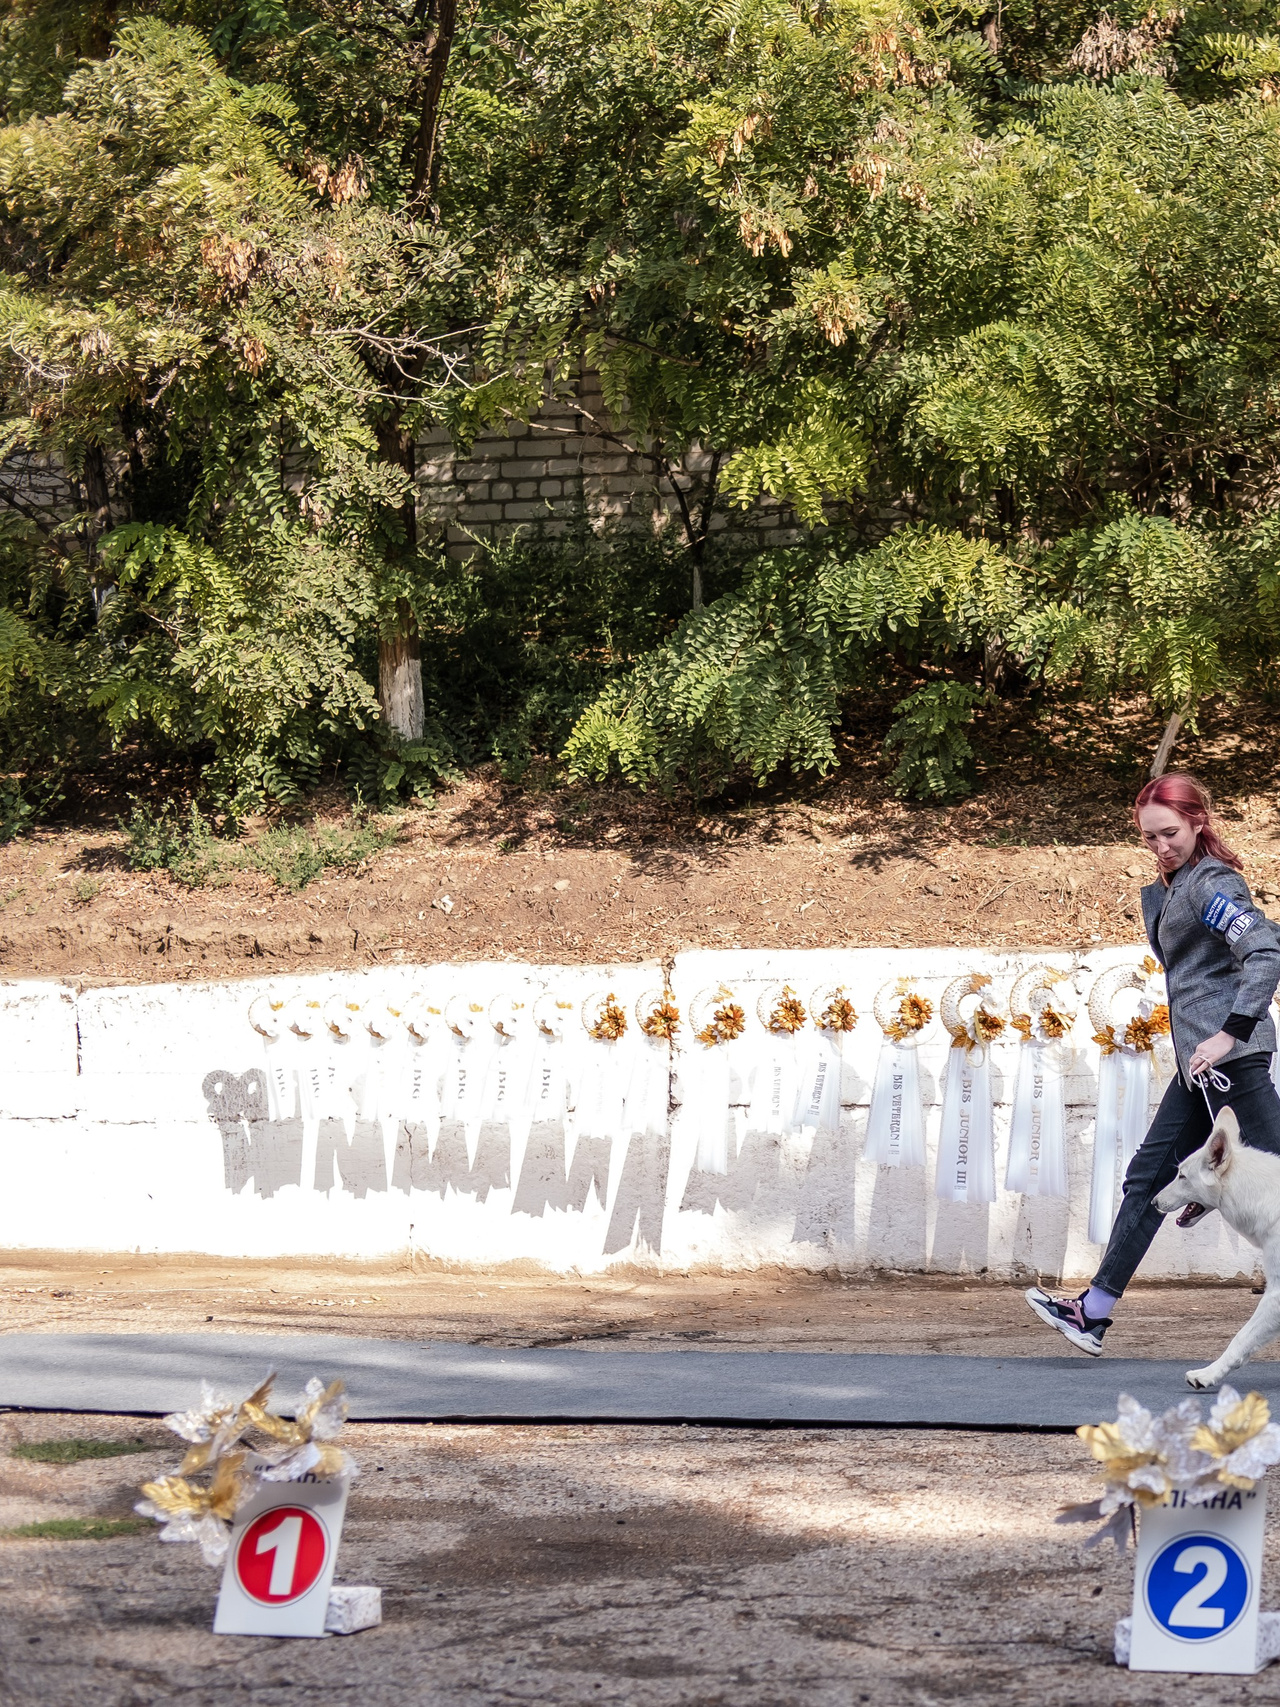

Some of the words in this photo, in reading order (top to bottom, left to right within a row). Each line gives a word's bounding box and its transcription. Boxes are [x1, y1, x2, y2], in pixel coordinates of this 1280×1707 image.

[1205, 896, 1222, 921] УЧАСТНИК
[893, 1074, 903, 1090] BIS
[961, 1079, 972, 1104] BIS
[1033, 1074, 1044, 1100] BIS
[889, 1093, 902, 1141] VETERAN
[1029, 1104, 1042, 1162] JUNIOR
[956, 1108, 970, 1166] JUNIOR
[956, 1170, 967, 1185] III
[255, 1516, 303, 1596] 1
[1168, 1545, 1228, 1629] 2
